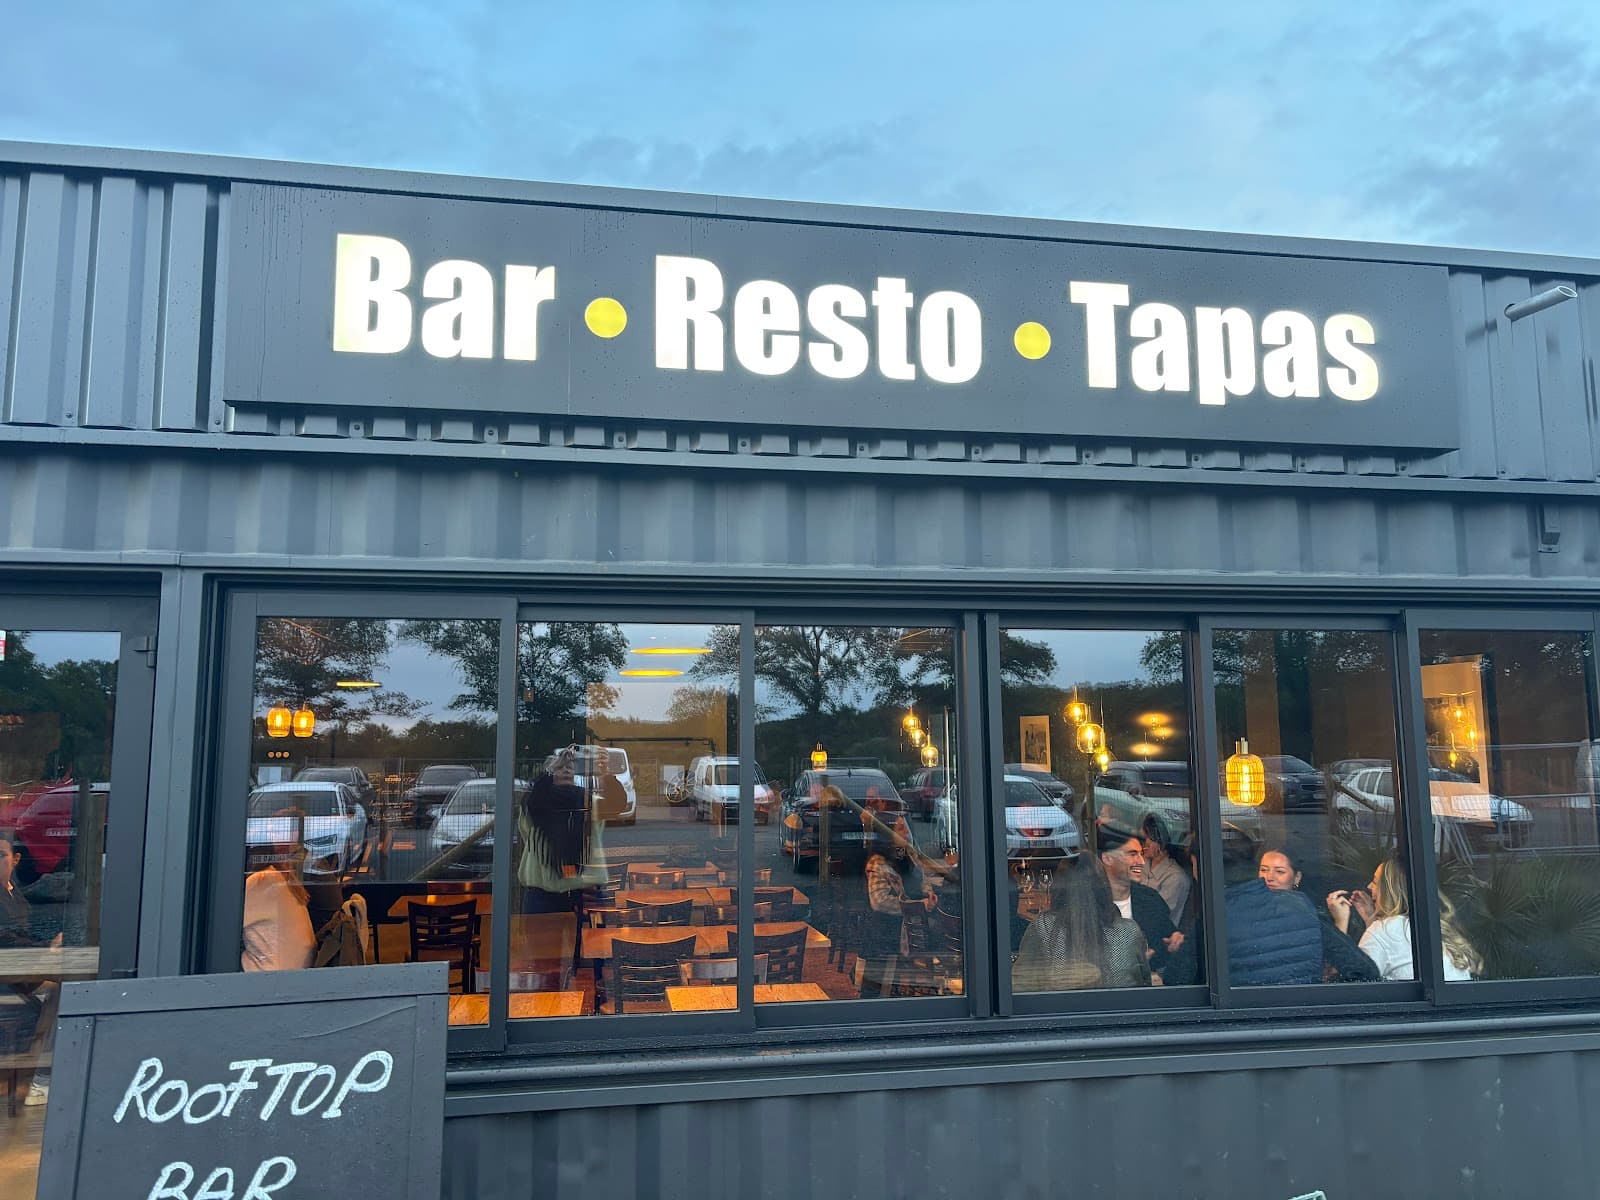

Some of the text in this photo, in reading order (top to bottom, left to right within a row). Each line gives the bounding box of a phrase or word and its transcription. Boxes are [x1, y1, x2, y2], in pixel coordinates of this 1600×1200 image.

[332, 232, 1382, 406] Bar Resto Tapas
[113, 1050, 394, 1125] ROOFTOP
[147, 1156, 297, 1200] BAR
